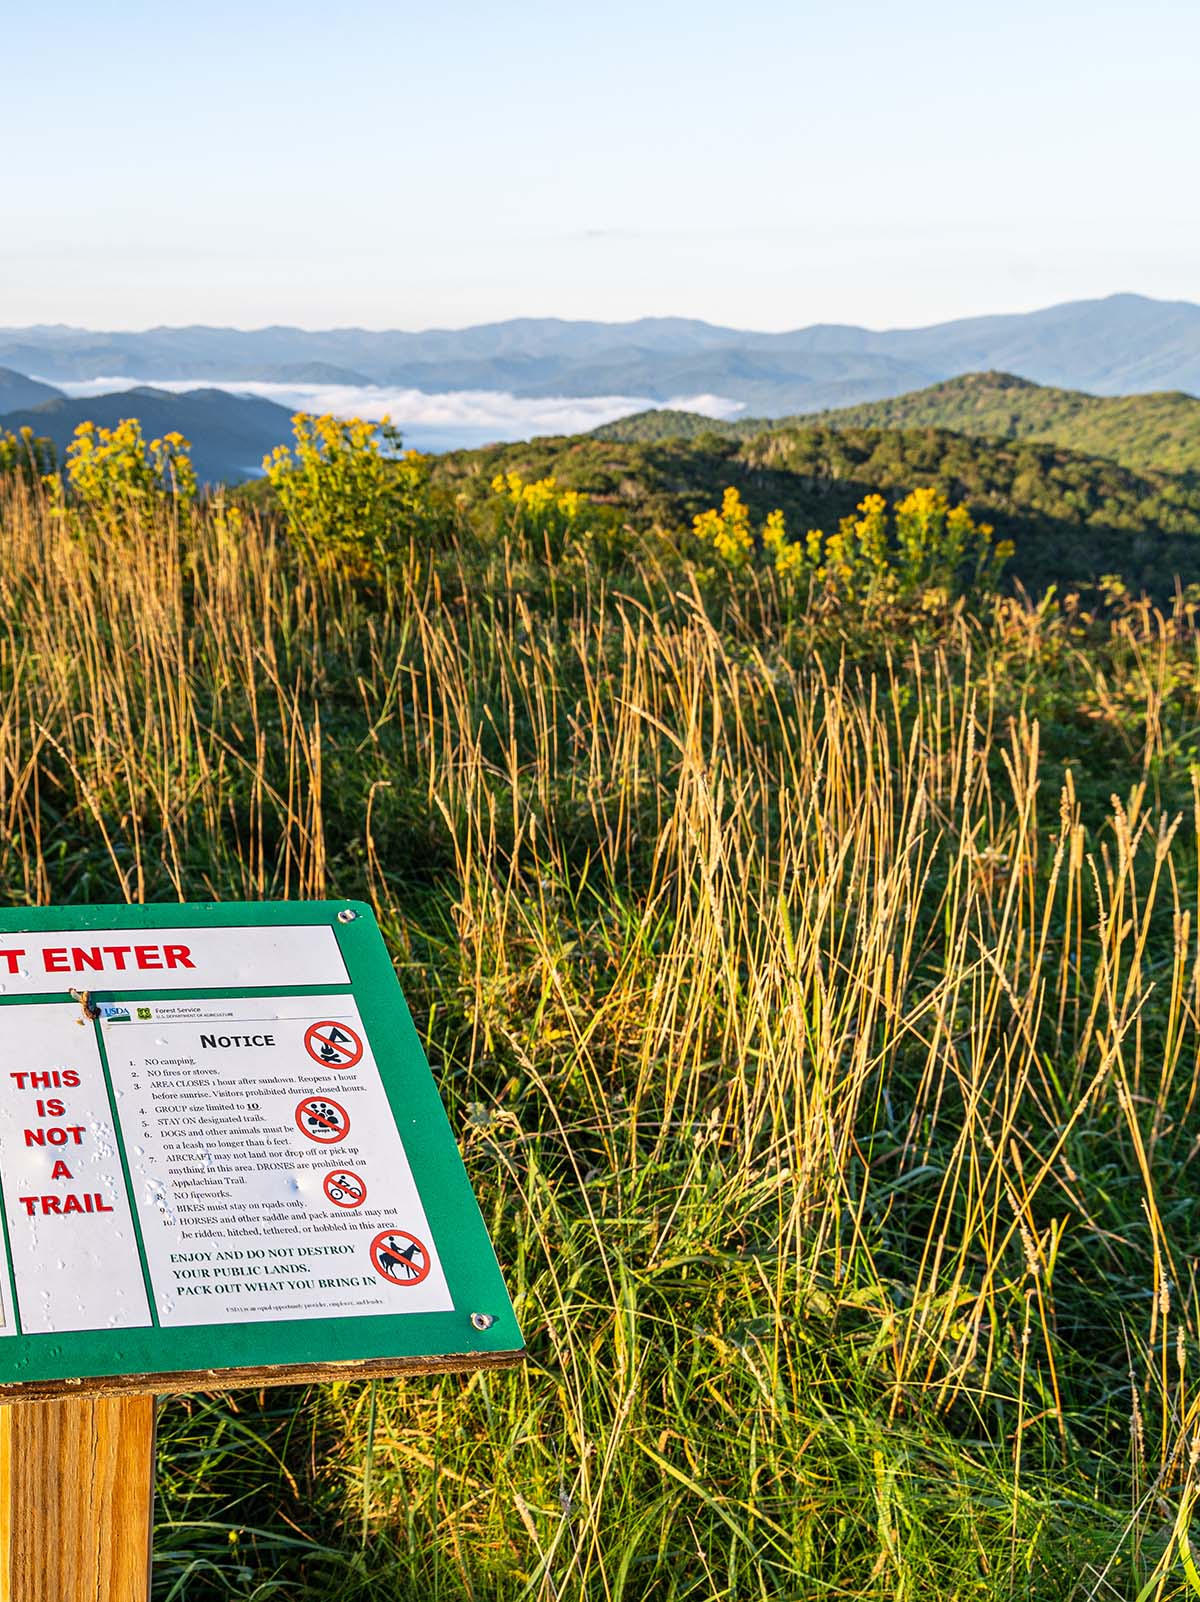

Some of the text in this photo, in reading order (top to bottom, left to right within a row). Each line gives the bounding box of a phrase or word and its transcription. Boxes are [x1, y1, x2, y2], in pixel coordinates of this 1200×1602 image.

[43, 944, 196, 972] ENTER
[160, 1057, 196, 1066] camping.
[10, 1070, 81, 1090] THIS
[299, 1074, 329, 1083] Reopens
[338, 1073, 357, 1081] hour
[180, 1090, 211, 1098] sunrise.
[213, 1088, 243, 1097] Visitors
[246, 1087, 286, 1098] prohibited
[288, 1086, 314, 1095] during
[316, 1085, 339, 1093] closed
[341, 1084, 367, 1092] hours.
[36, 1099, 66, 1117] IS
[206, 1103, 234, 1111] limited
[199, 1115, 241, 1125] designated
[244, 1114, 266, 1122] trails.
[24, 1127, 86, 1147] NOT
[206, 1127, 227, 1135] other
[229, 1126, 260, 1134] animals
[218, 1140, 247, 1150] longer
[249, 1138, 264, 1146] than
[166, 1153, 212, 1162] AIRCRAFT
[214, 1153, 231, 1161] may
[233, 1151, 247, 1159] not
[249, 1150, 267, 1158] land
[285, 1149, 303, 1159] drop
[306, 1148, 317, 1156] off
[330, 1147, 346, 1157] pick
[349, 1147, 359, 1155] up
[51, 1160, 72, 1180] A
[169, 1165, 205, 1175] anything
[257, 1162, 295, 1171] DRONES
[312, 1159, 353, 1170] prohibited
[171, 1177, 247, 1189] Appalachian Trail.
[190, 1190, 232, 1199] fireworks.
[19, 1193, 113, 1217] TRAIL
[177, 1204, 205, 1213] BIKES
[207, 1203, 228, 1211] must
[230, 1203, 247, 1212] stay
[286, 1200, 307, 1209] only.
[180, 1216, 218, 1225] HORSES
[220, 1214, 236, 1223] and
[238, 1213, 260, 1222] other
[262, 1211, 289, 1221] saddle
[291, 1211, 307, 1220] and
[309, 1210, 328, 1221] pack
[330, 1209, 363, 1218] animals
[364, 1209, 382, 1217] may
[384, 1207, 398, 1215] not
[182, 1231, 192, 1239] be
[195, 1229, 225, 1239] ridden,
[228, 1227, 261, 1238] hitched,
[263, 1225, 300, 1235] tethered,
[314, 1222, 347, 1232] hobbled
[349, 1222, 358, 1230] in
[360, 1221, 376, 1229] this
[170, 1245, 356, 1263] ENJOY AND DO NOT DESTROY
[173, 1264, 310, 1279] YOUR PUBLIC LANDS.
[177, 1276, 376, 1296] PACK OUT WHAT YOU BRING IN
